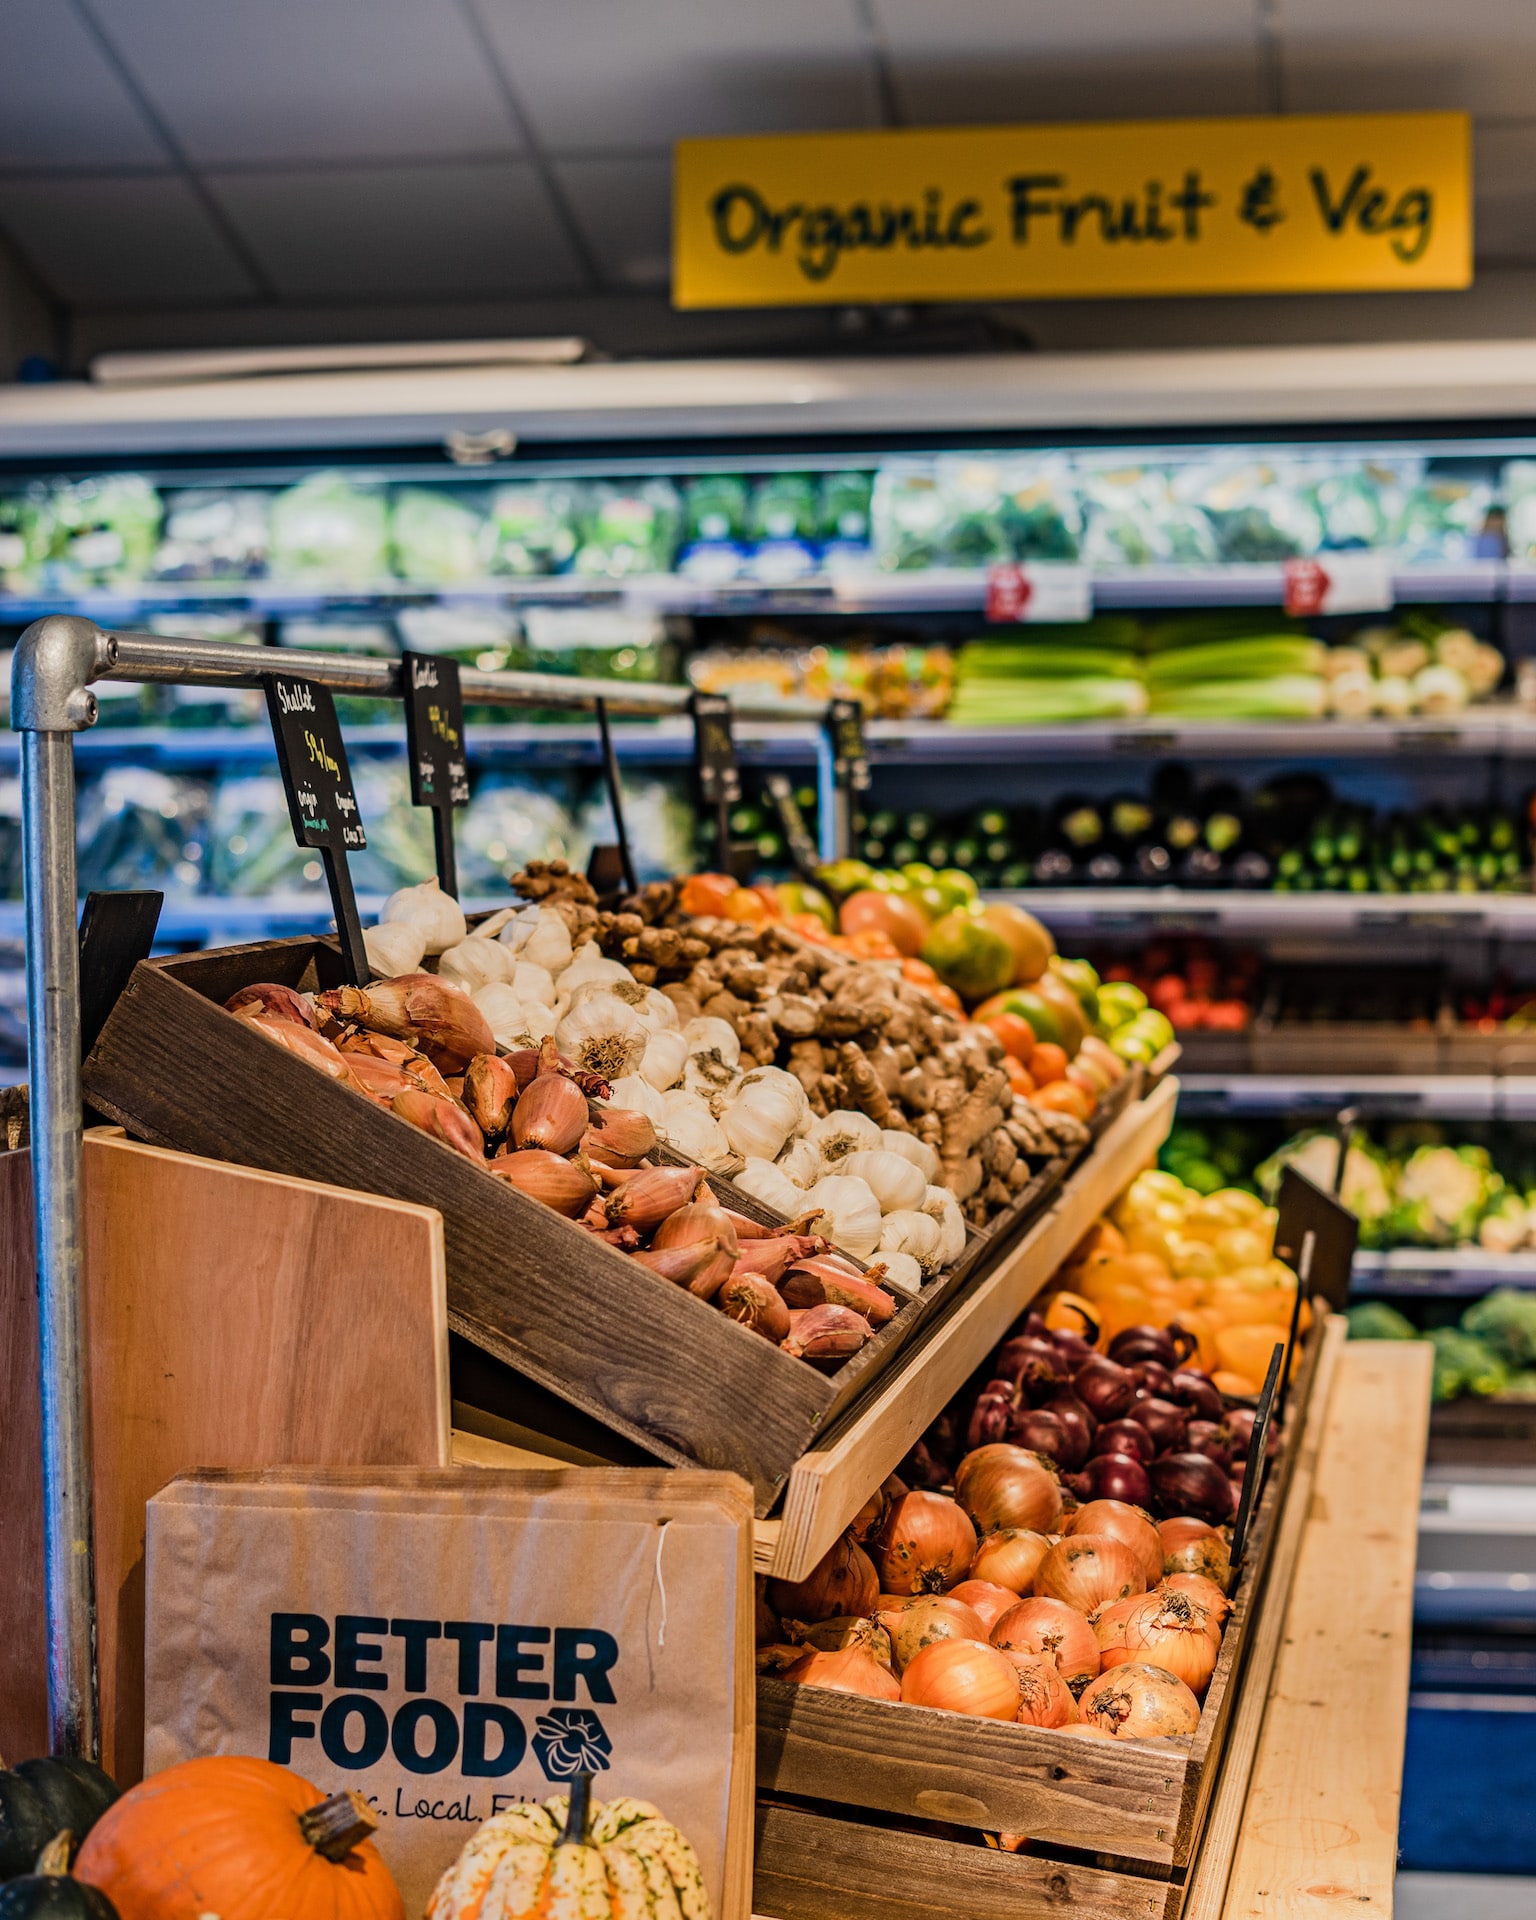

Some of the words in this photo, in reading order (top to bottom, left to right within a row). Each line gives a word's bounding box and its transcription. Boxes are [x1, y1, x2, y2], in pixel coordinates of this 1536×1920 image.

[709, 182, 990, 282] Organic
[1006, 169, 1216, 244] Fruit
[1239, 164, 1285, 235] &
[1308, 164, 1436, 263] Veg
[277, 681, 316, 714] Shallot
[271, 1613, 618, 1704] BETTER
[269, 1691, 526, 1778] FOOD
[395, 1787, 483, 1822] Local.
